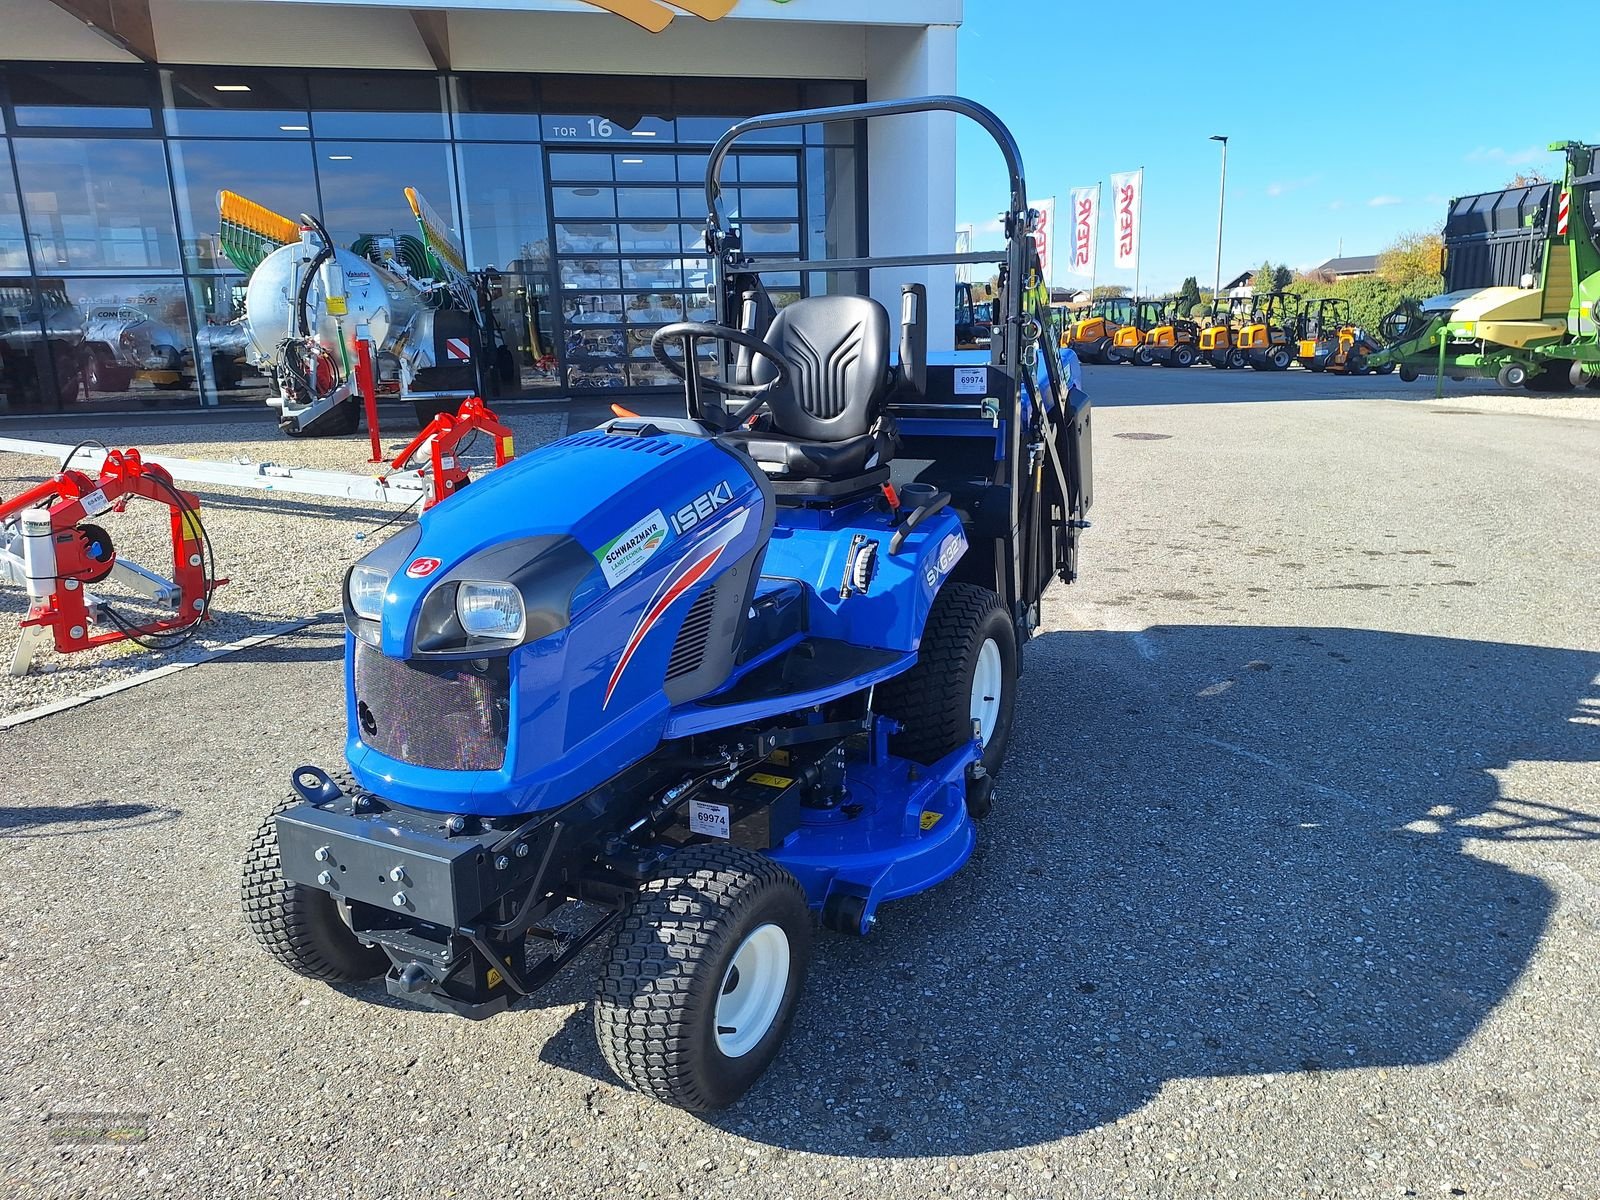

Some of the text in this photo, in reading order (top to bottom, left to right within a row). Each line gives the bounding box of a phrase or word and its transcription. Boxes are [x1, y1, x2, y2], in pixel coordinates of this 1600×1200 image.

[553, 118, 613, 137] TOR 16
[124, 296, 158, 304] STEYR
[961, 376, 984, 384] 69974
[670, 480, 734, 535] ISEKI
[606, 523, 658, 564] SCHWARZMAYR
[610, 546, 644, 571] LANDTECHNIK
[926, 532, 962, 587] SXG327
[697, 812, 725, 825] 69974
